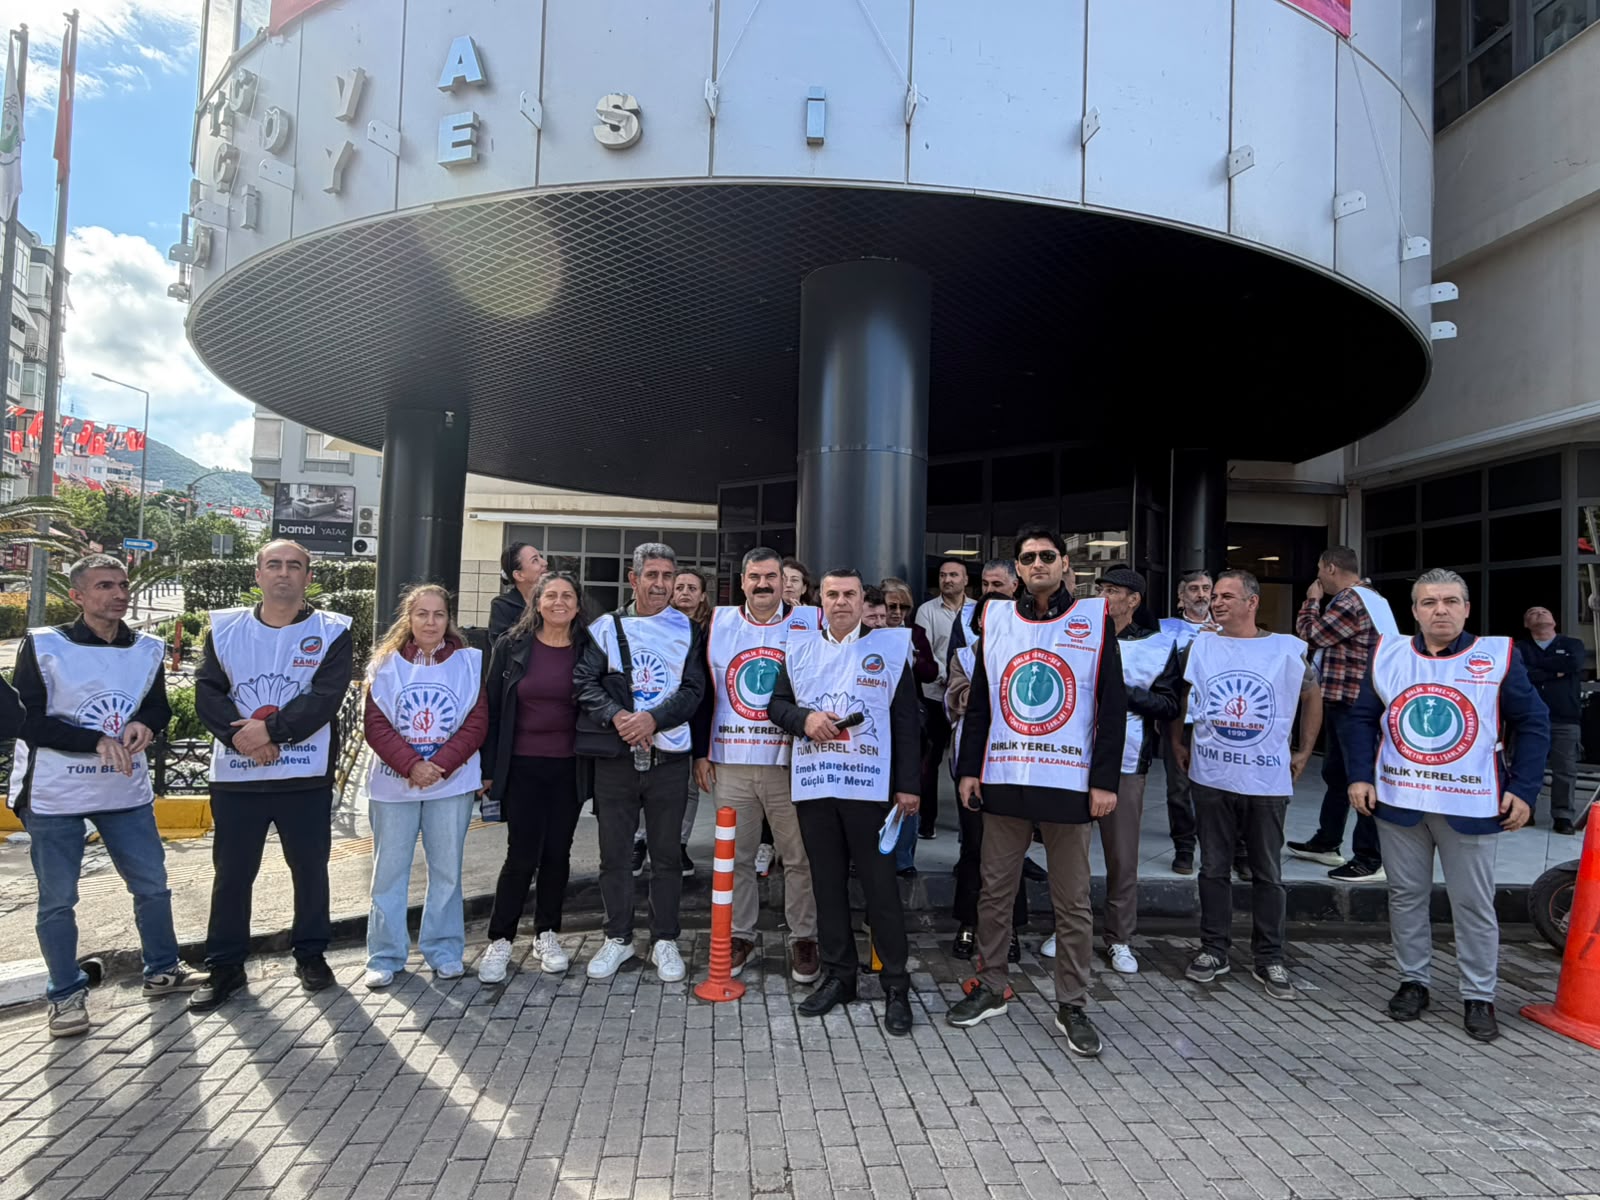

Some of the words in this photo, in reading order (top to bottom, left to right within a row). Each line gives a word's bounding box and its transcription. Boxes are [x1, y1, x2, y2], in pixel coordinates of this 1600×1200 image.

[278, 523, 316, 536] bambi
[320, 527, 347, 537] YATAK
[1229, 721, 1265, 730] BEL-SEN
[813, 743, 850, 754] YEREL
[859, 745, 879, 757] SEN
[991, 741, 1018, 751] BİRLİK
[1021, 742, 1083, 756] YEREL-SEN
[1197, 744, 1219, 761] TÜM
[1223, 751, 1281, 767] BEL-SEN
[281, 755, 311, 766] Mevzi
[66, 764, 97, 774] TÜM
[796, 762, 817, 774] Emek
[819, 761, 882, 776] Hareketinde
[1382, 764, 1411, 778] BİRLİK
[1415, 770, 1482, 785] YEREL-SEN
[800, 774, 825, 788] Güçlü
[827, 773, 842, 784] Bir
[844, 776, 875, 788] Mevzi
